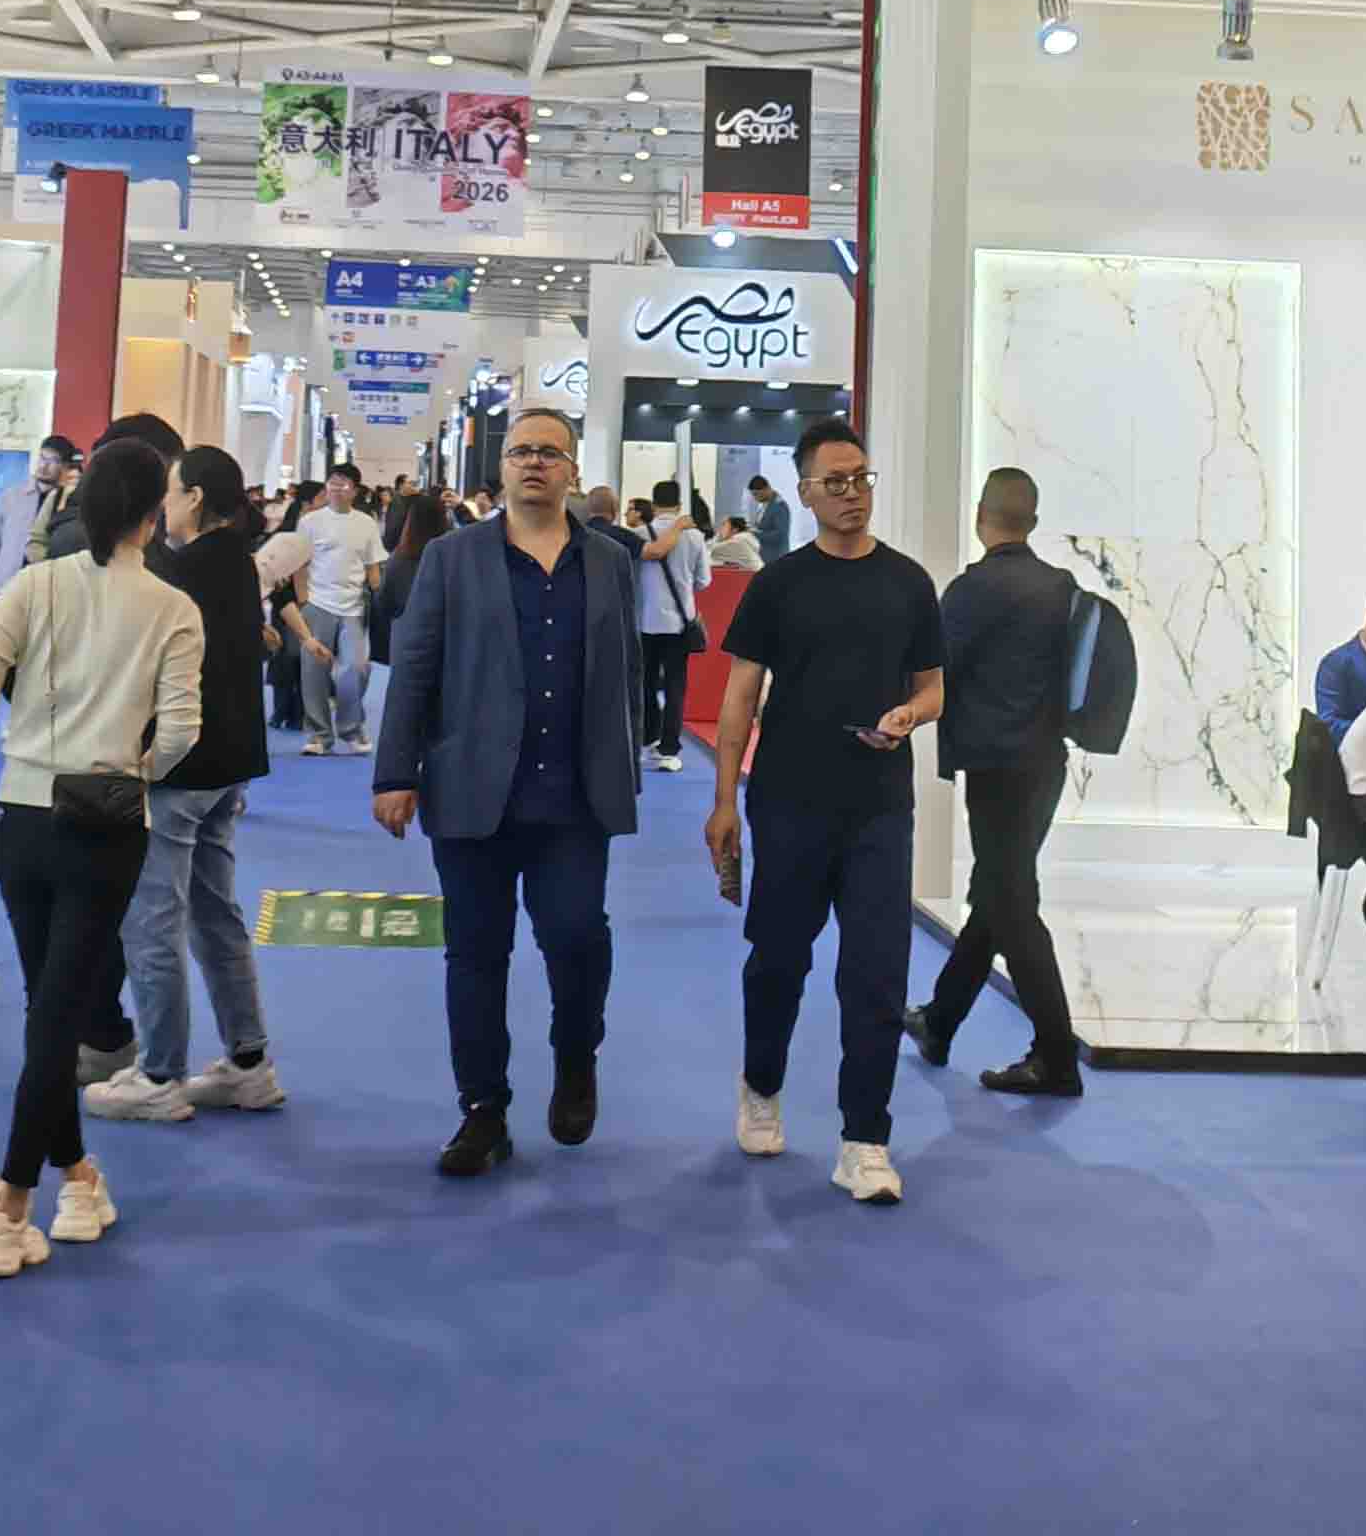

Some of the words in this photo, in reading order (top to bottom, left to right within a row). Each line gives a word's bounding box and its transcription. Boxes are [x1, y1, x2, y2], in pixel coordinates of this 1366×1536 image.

[735, 117, 800, 145] Egypt
[278, 124, 376, 157] 意大利
[394, 129, 509, 164] ITALY
[453, 180, 510, 203] 2026
[730, 199, 759, 212] Hall
[336, 270, 364, 287] A4
[675, 313, 810, 369] Egypt
